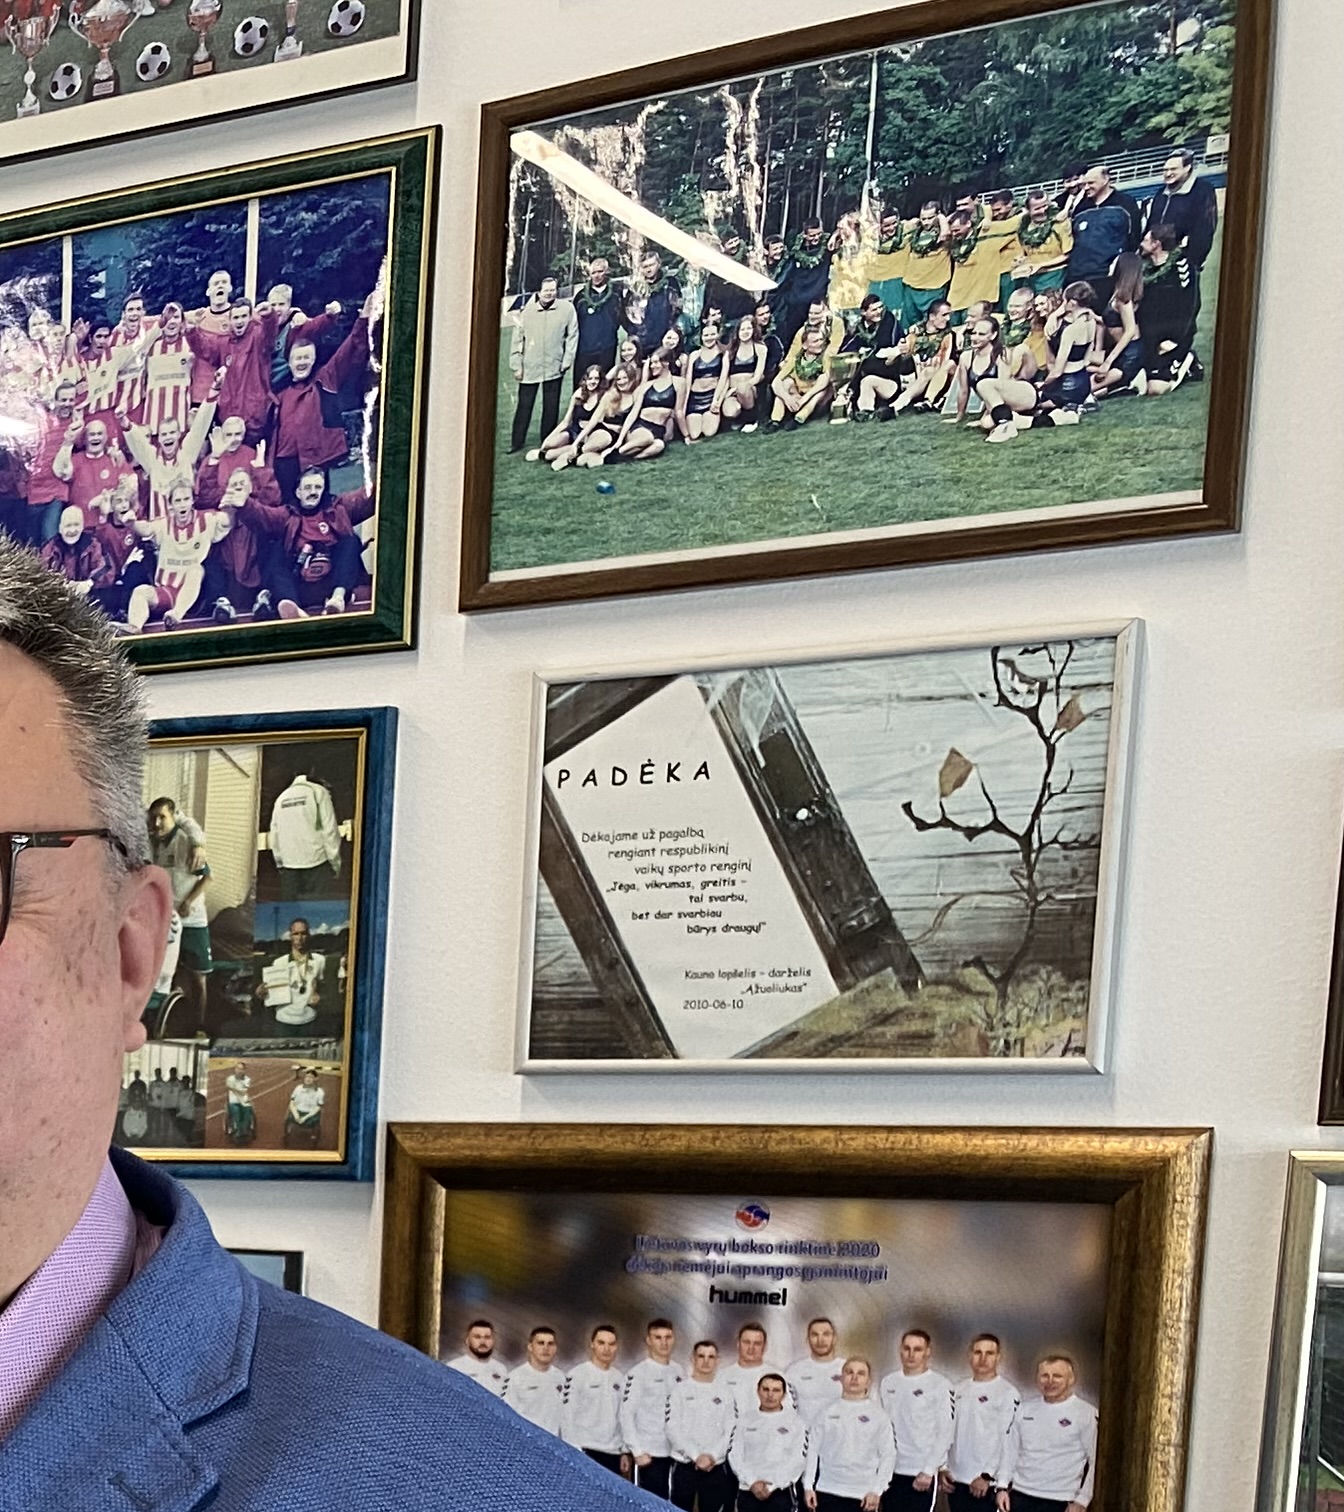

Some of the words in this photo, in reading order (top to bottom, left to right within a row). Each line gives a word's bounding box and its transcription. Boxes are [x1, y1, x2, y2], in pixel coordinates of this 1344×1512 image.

[557, 758, 711, 789] PADĖKA
[581, 830, 638, 845] Dėkojame
[642, 828, 656, 841] už
[659, 827, 705, 843] pagalbą
[608, 847, 656, 860] rengiant
[660, 842, 729, 858] respublikinį
[634, 863, 665, 877] vaikų
[668, 862, 707, 876] sporto
[710, 859, 752, 873] renginį
[645, 879, 695, 891] vikrumas,
[700, 877, 736, 890] greitis
[689, 894, 703, 904] tai
[708, 893, 748, 905] svarbu,
[631, 910, 650, 921] bet
[654, 910, 673, 920] dar
[677, 908, 722, 920] svarbiau
[686, 922, 717, 936] būrys
[685, 969, 715, 980] Kauno
[718, 967, 756, 981] lopšelis
[768, 967, 811, 978] darželis
[683, 998, 744, 1010] 2010-06-10
[730, 1237, 774, 1255] bokso
[709, 1284, 788, 1307] hummel
